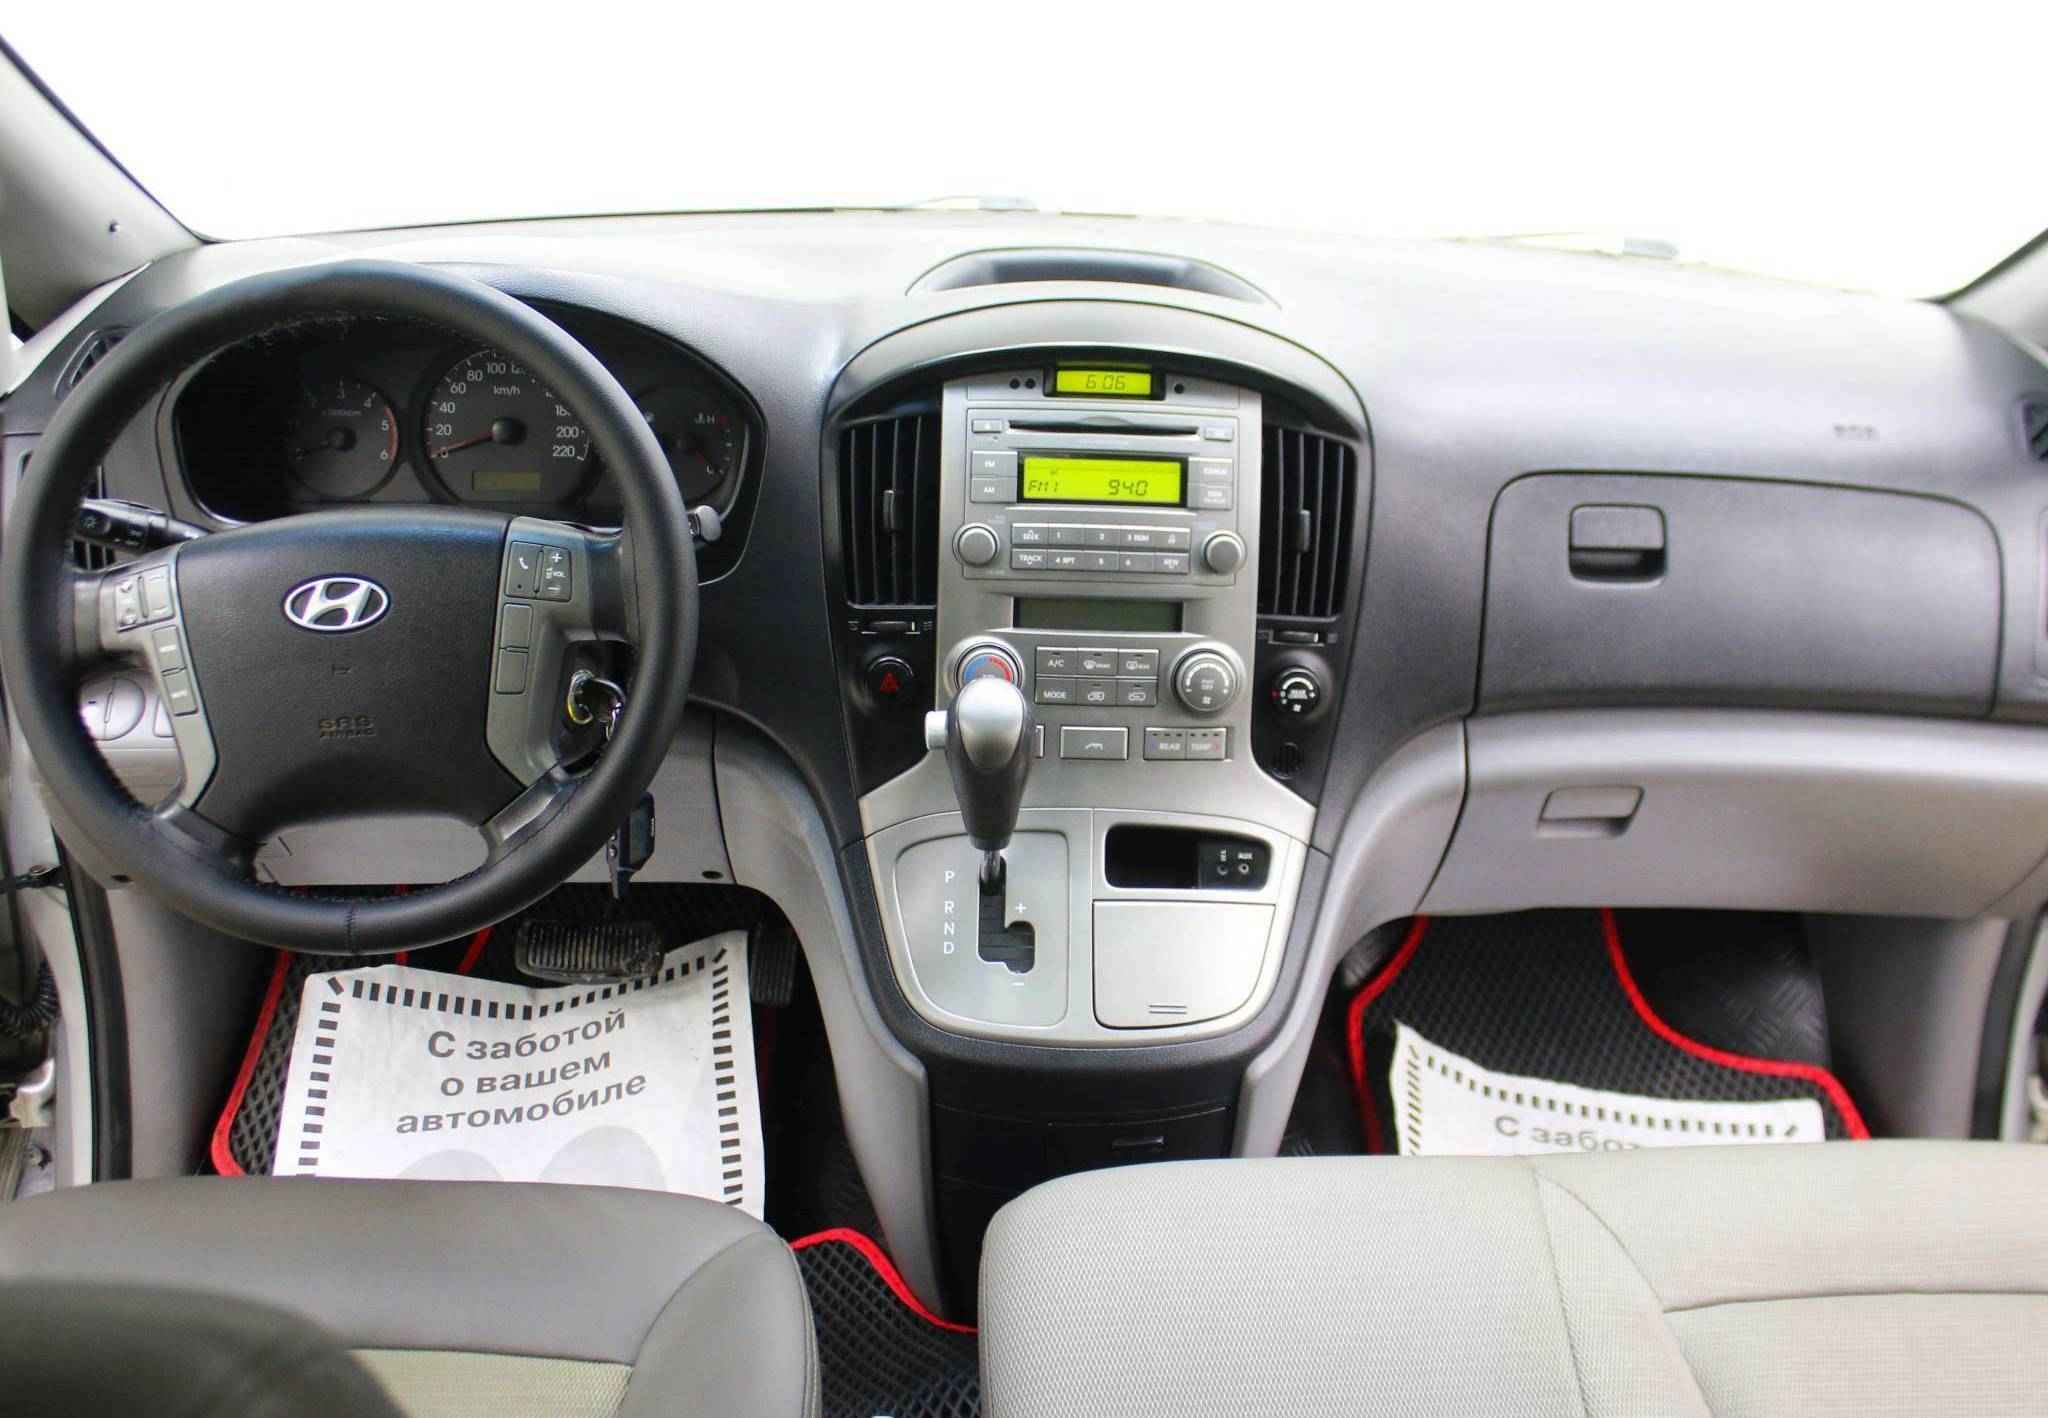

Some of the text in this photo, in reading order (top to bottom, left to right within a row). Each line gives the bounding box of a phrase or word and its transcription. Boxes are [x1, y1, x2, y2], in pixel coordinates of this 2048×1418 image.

[486, 362, 506, 374] 100
[467, 370, 483, 382] 80
[450, 382, 466, 394] 60
[493, 385, 520, 396] km/h
[439, 402, 456, 413] 40
[381, 419, 390, 432] 5
[435, 424, 452, 436] 20
[556, 426, 579, 438] 200
[379, 448, 389, 460] 6
[552, 446, 575, 457] 220
[944, 870, 955, 883] P
[944, 901, 954, 913] R
[944, 921, 954, 935] N
[944, 941, 954, 954] D
[427, 1008, 627, 1061] С заботой
[440, 1050, 611, 1097] о вашем
[396, 1073, 647, 1134] автомобиле
[1495, 1115, 1520, 1137] С
